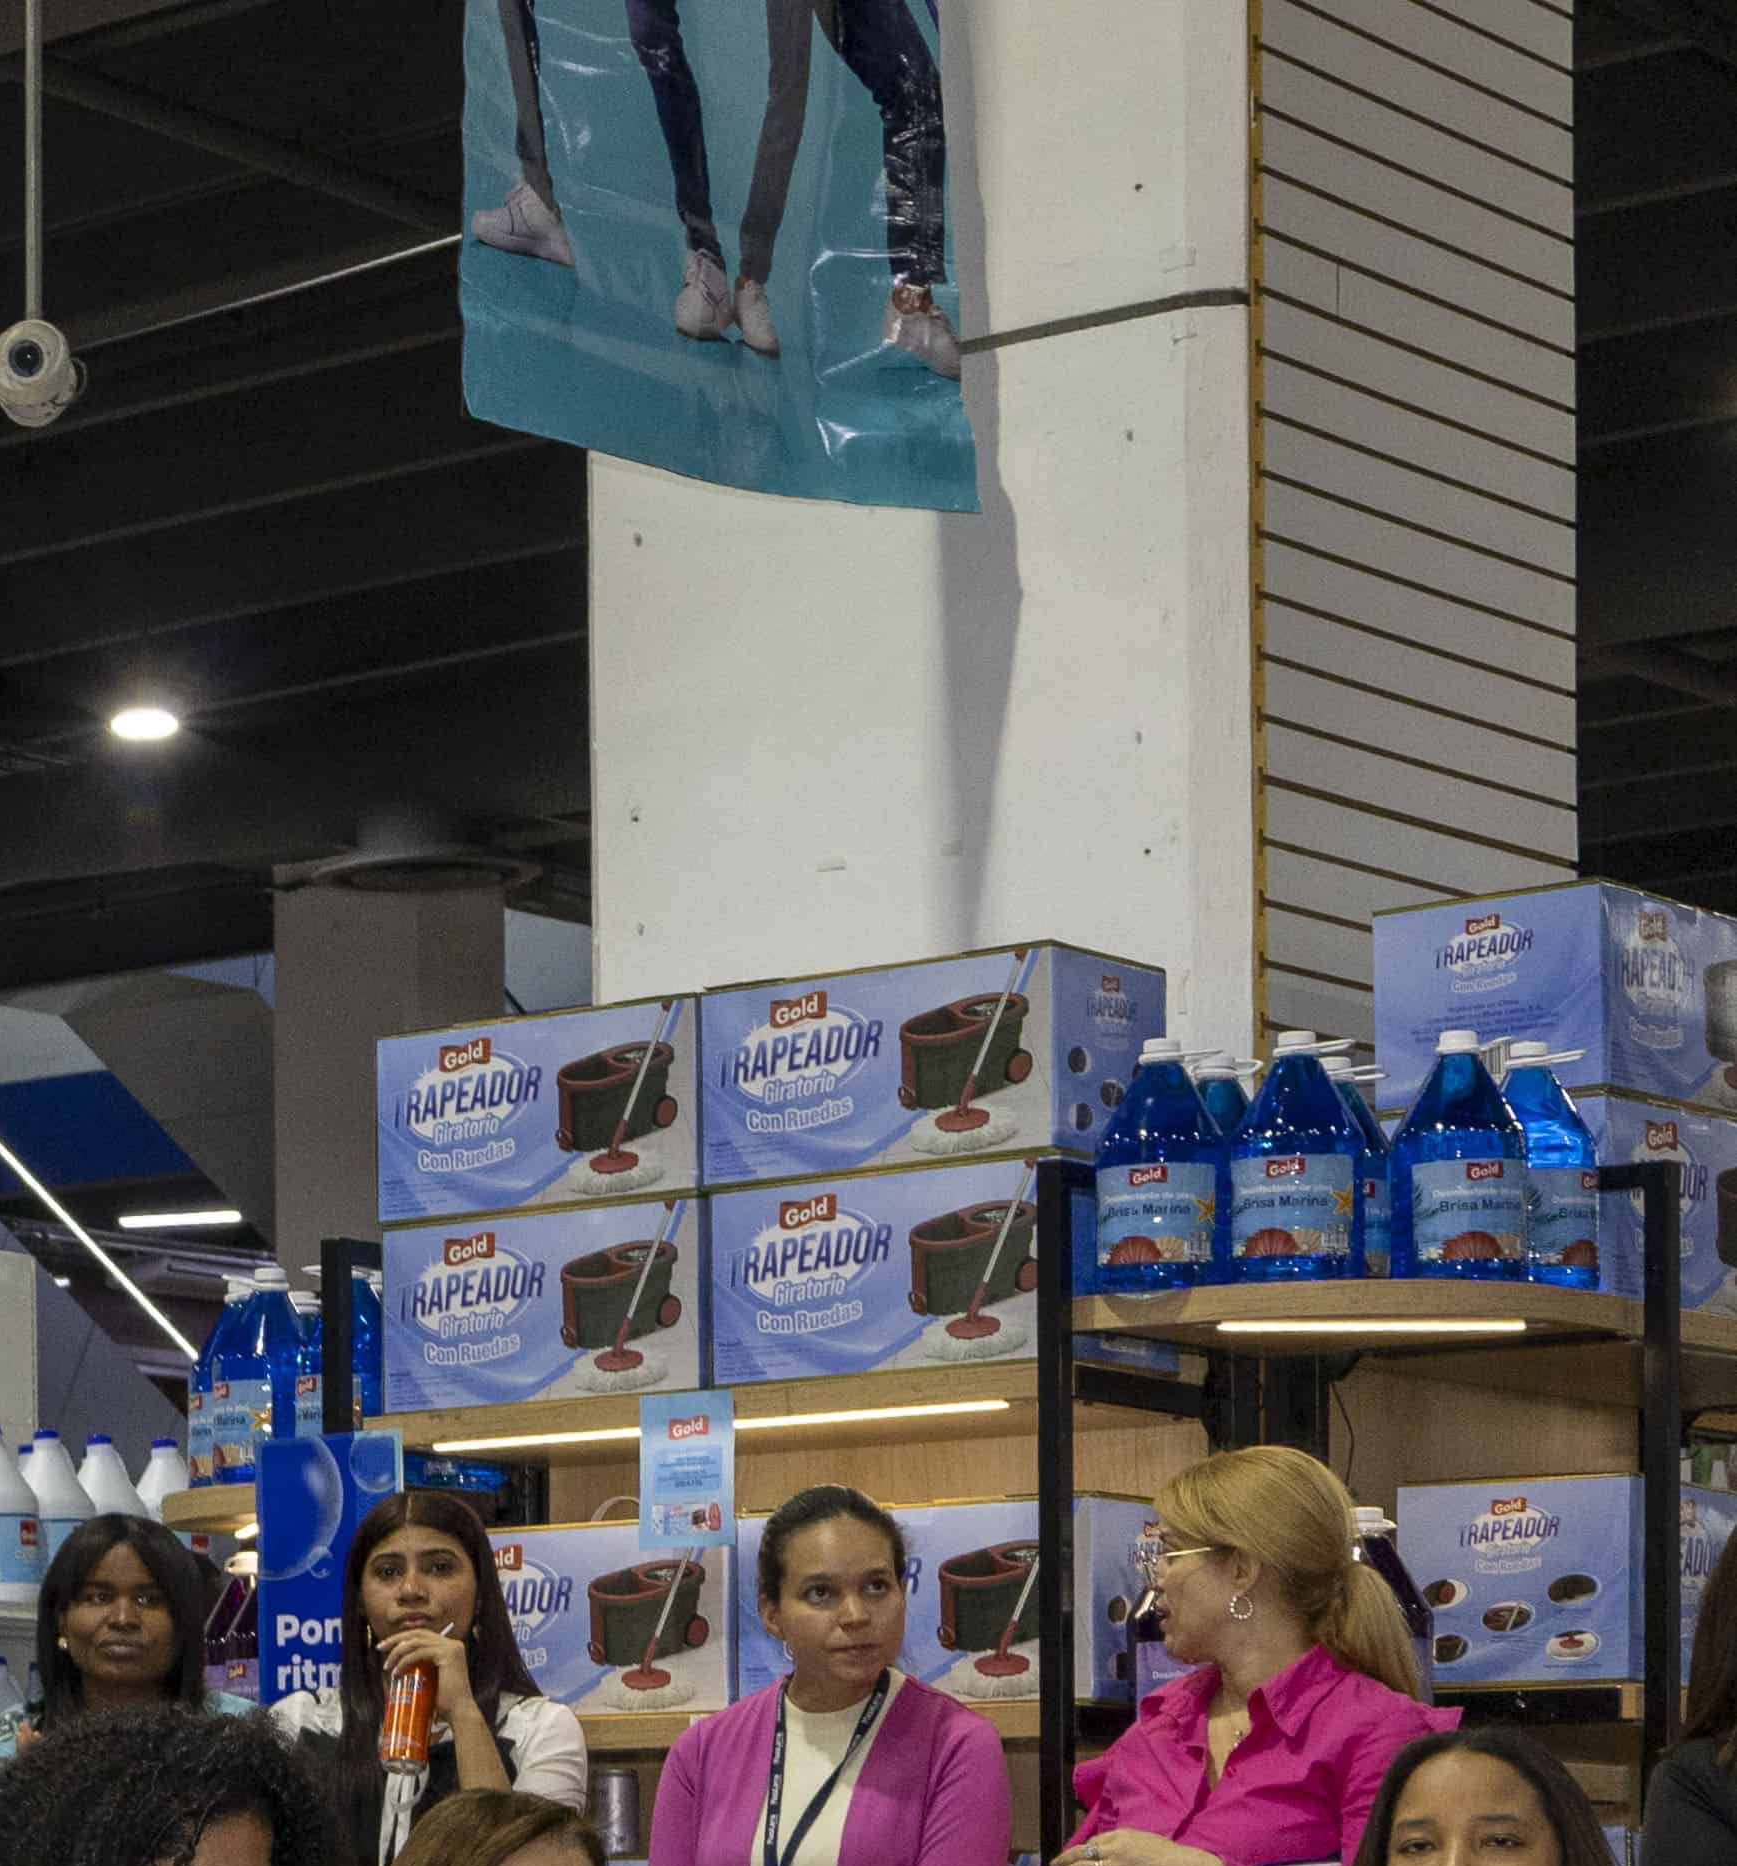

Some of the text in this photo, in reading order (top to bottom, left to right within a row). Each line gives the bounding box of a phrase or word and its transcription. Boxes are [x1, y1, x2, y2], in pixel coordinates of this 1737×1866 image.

[1469, 917, 1496, 933] Gold
[1435, 928, 1535, 968] TRAPEADOR
[775, 995, 819, 1024] Gold
[445, 1042, 484, 1069] Gold
[714, 1019, 884, 1088] TRAPEADOR
[395, 1065, 543, 1128] TRAPEADOR
[764, 1074, 837, 1102] Giratorio
[432, 1112, 499, 1142] Giratorio
[748, 1097, 854, 1132] Con Ruedas
[417, 1137, 515, 1170] Con Ruedas
[1133, 1167, 1162, 1184] Gold
[1269, 1161, 1300, 1177] Gold
[1471, 1164, 1499, 1178] Gold
[785, 1198, 828, 1225] Gold
[1142, 1204, 1192, 1216] Marina
[1439, 1200, 1479, 1213] Brisa
[449, 1238, 488, 1262] Gold
[725, 1223, 893, 1288] TRAPEADOR
[398, 1261, 546, 1321] TRAPEADOR
[774, 1275, 847, 1306] Giratorio
[438, 1311, 505, 1340] Giratorio
[758, 1300, 864, 1333] Con Ruedas
[424, 1333, 521, 1365] Con Ruedas
[673, 1416, 704, 1437] Gold
[1494, 1500, 1522, 1514] Gold
[1459, 1515, 1561, 1547] TRAPEADOR
[494, 1547, 515, 1567] ld
[277, 1614, 342, 1644] Pon
